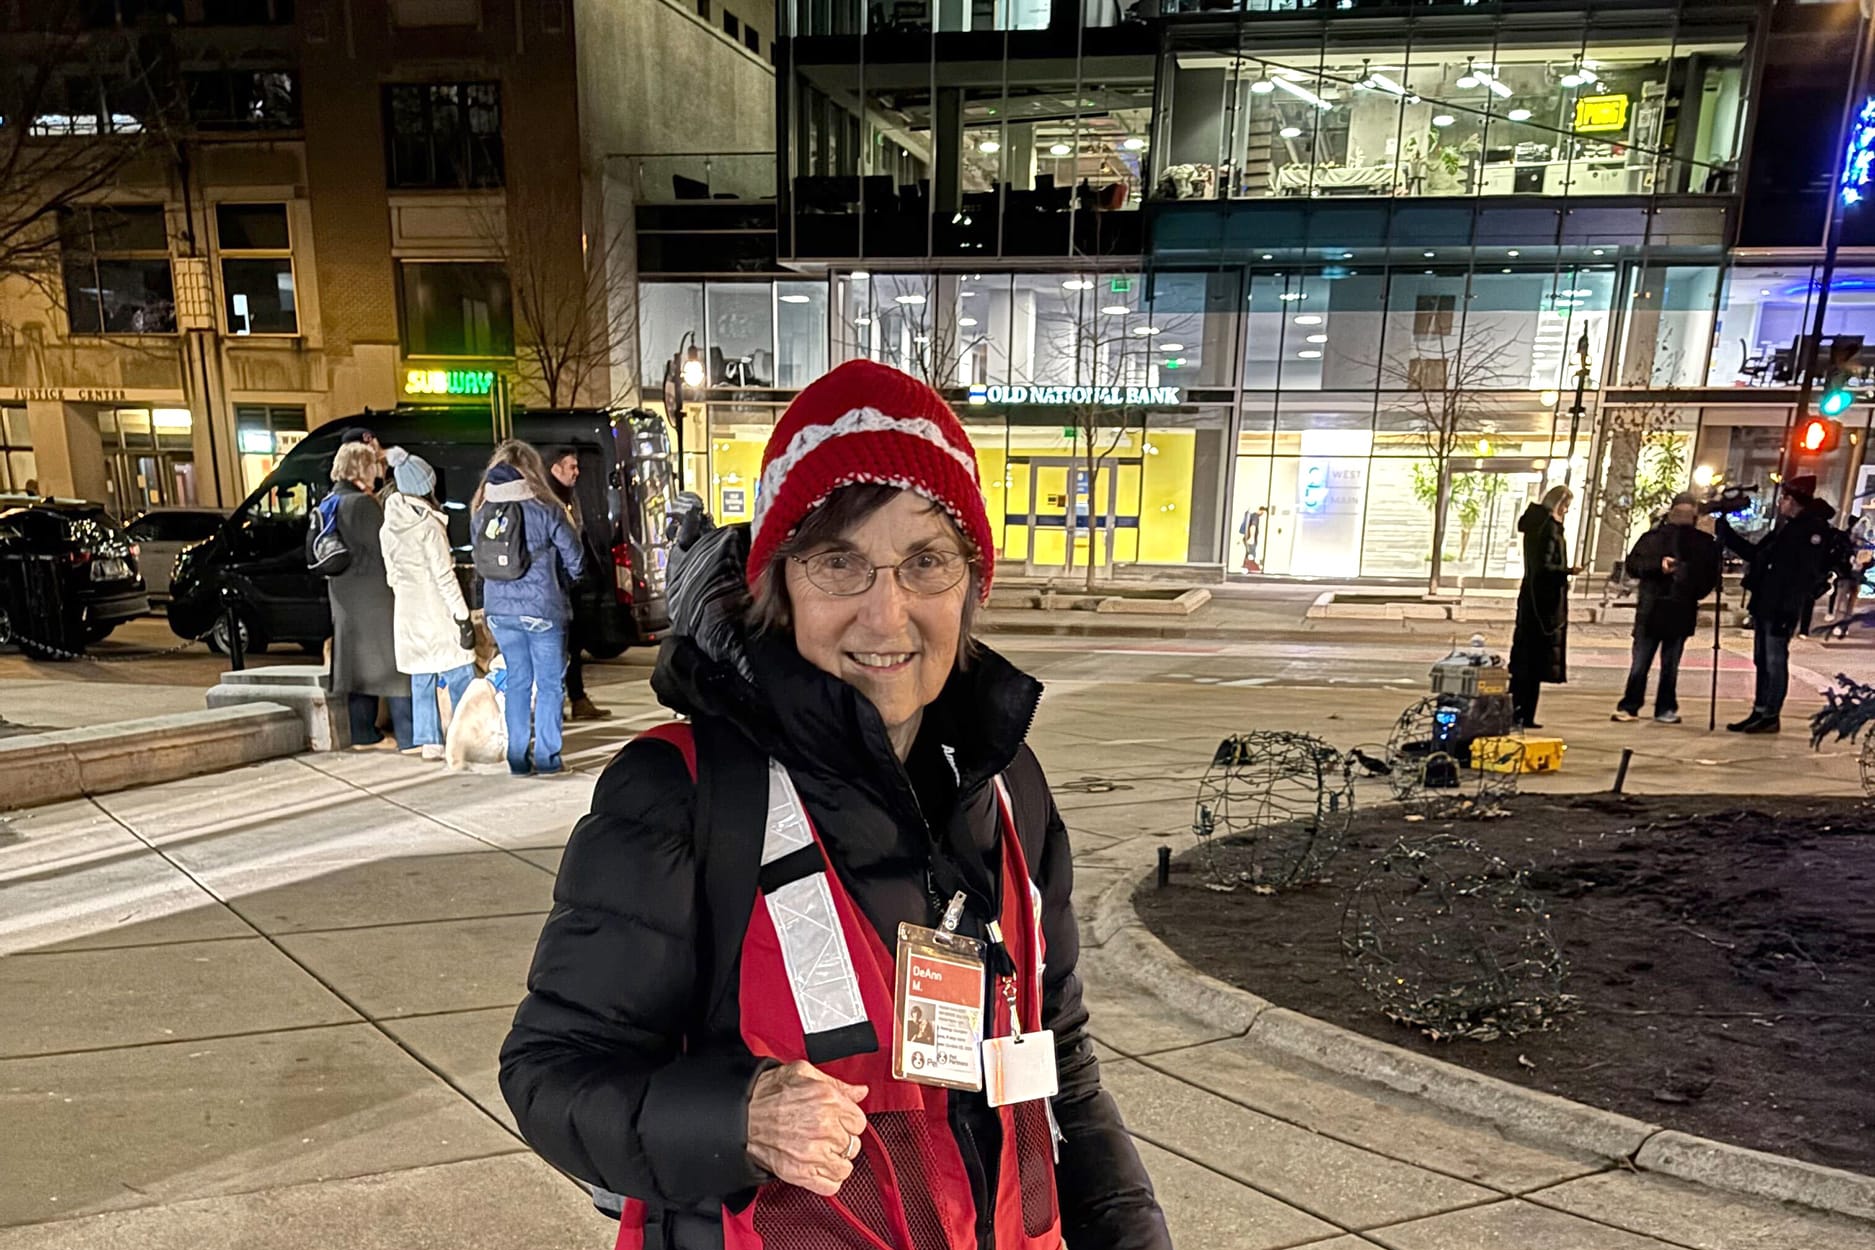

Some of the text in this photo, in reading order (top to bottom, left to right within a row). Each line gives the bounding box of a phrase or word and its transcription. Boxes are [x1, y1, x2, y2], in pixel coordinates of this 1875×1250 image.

[405, 370, 494, 394] SUBWAY
[14, 388, 126, 401] JUSTICE CENTER
[987, 386, 1180, 405] OLD NATIONAL BANK
[912, 965, 943, 982] DeAnn
[911, 980, 924, 992] M.
